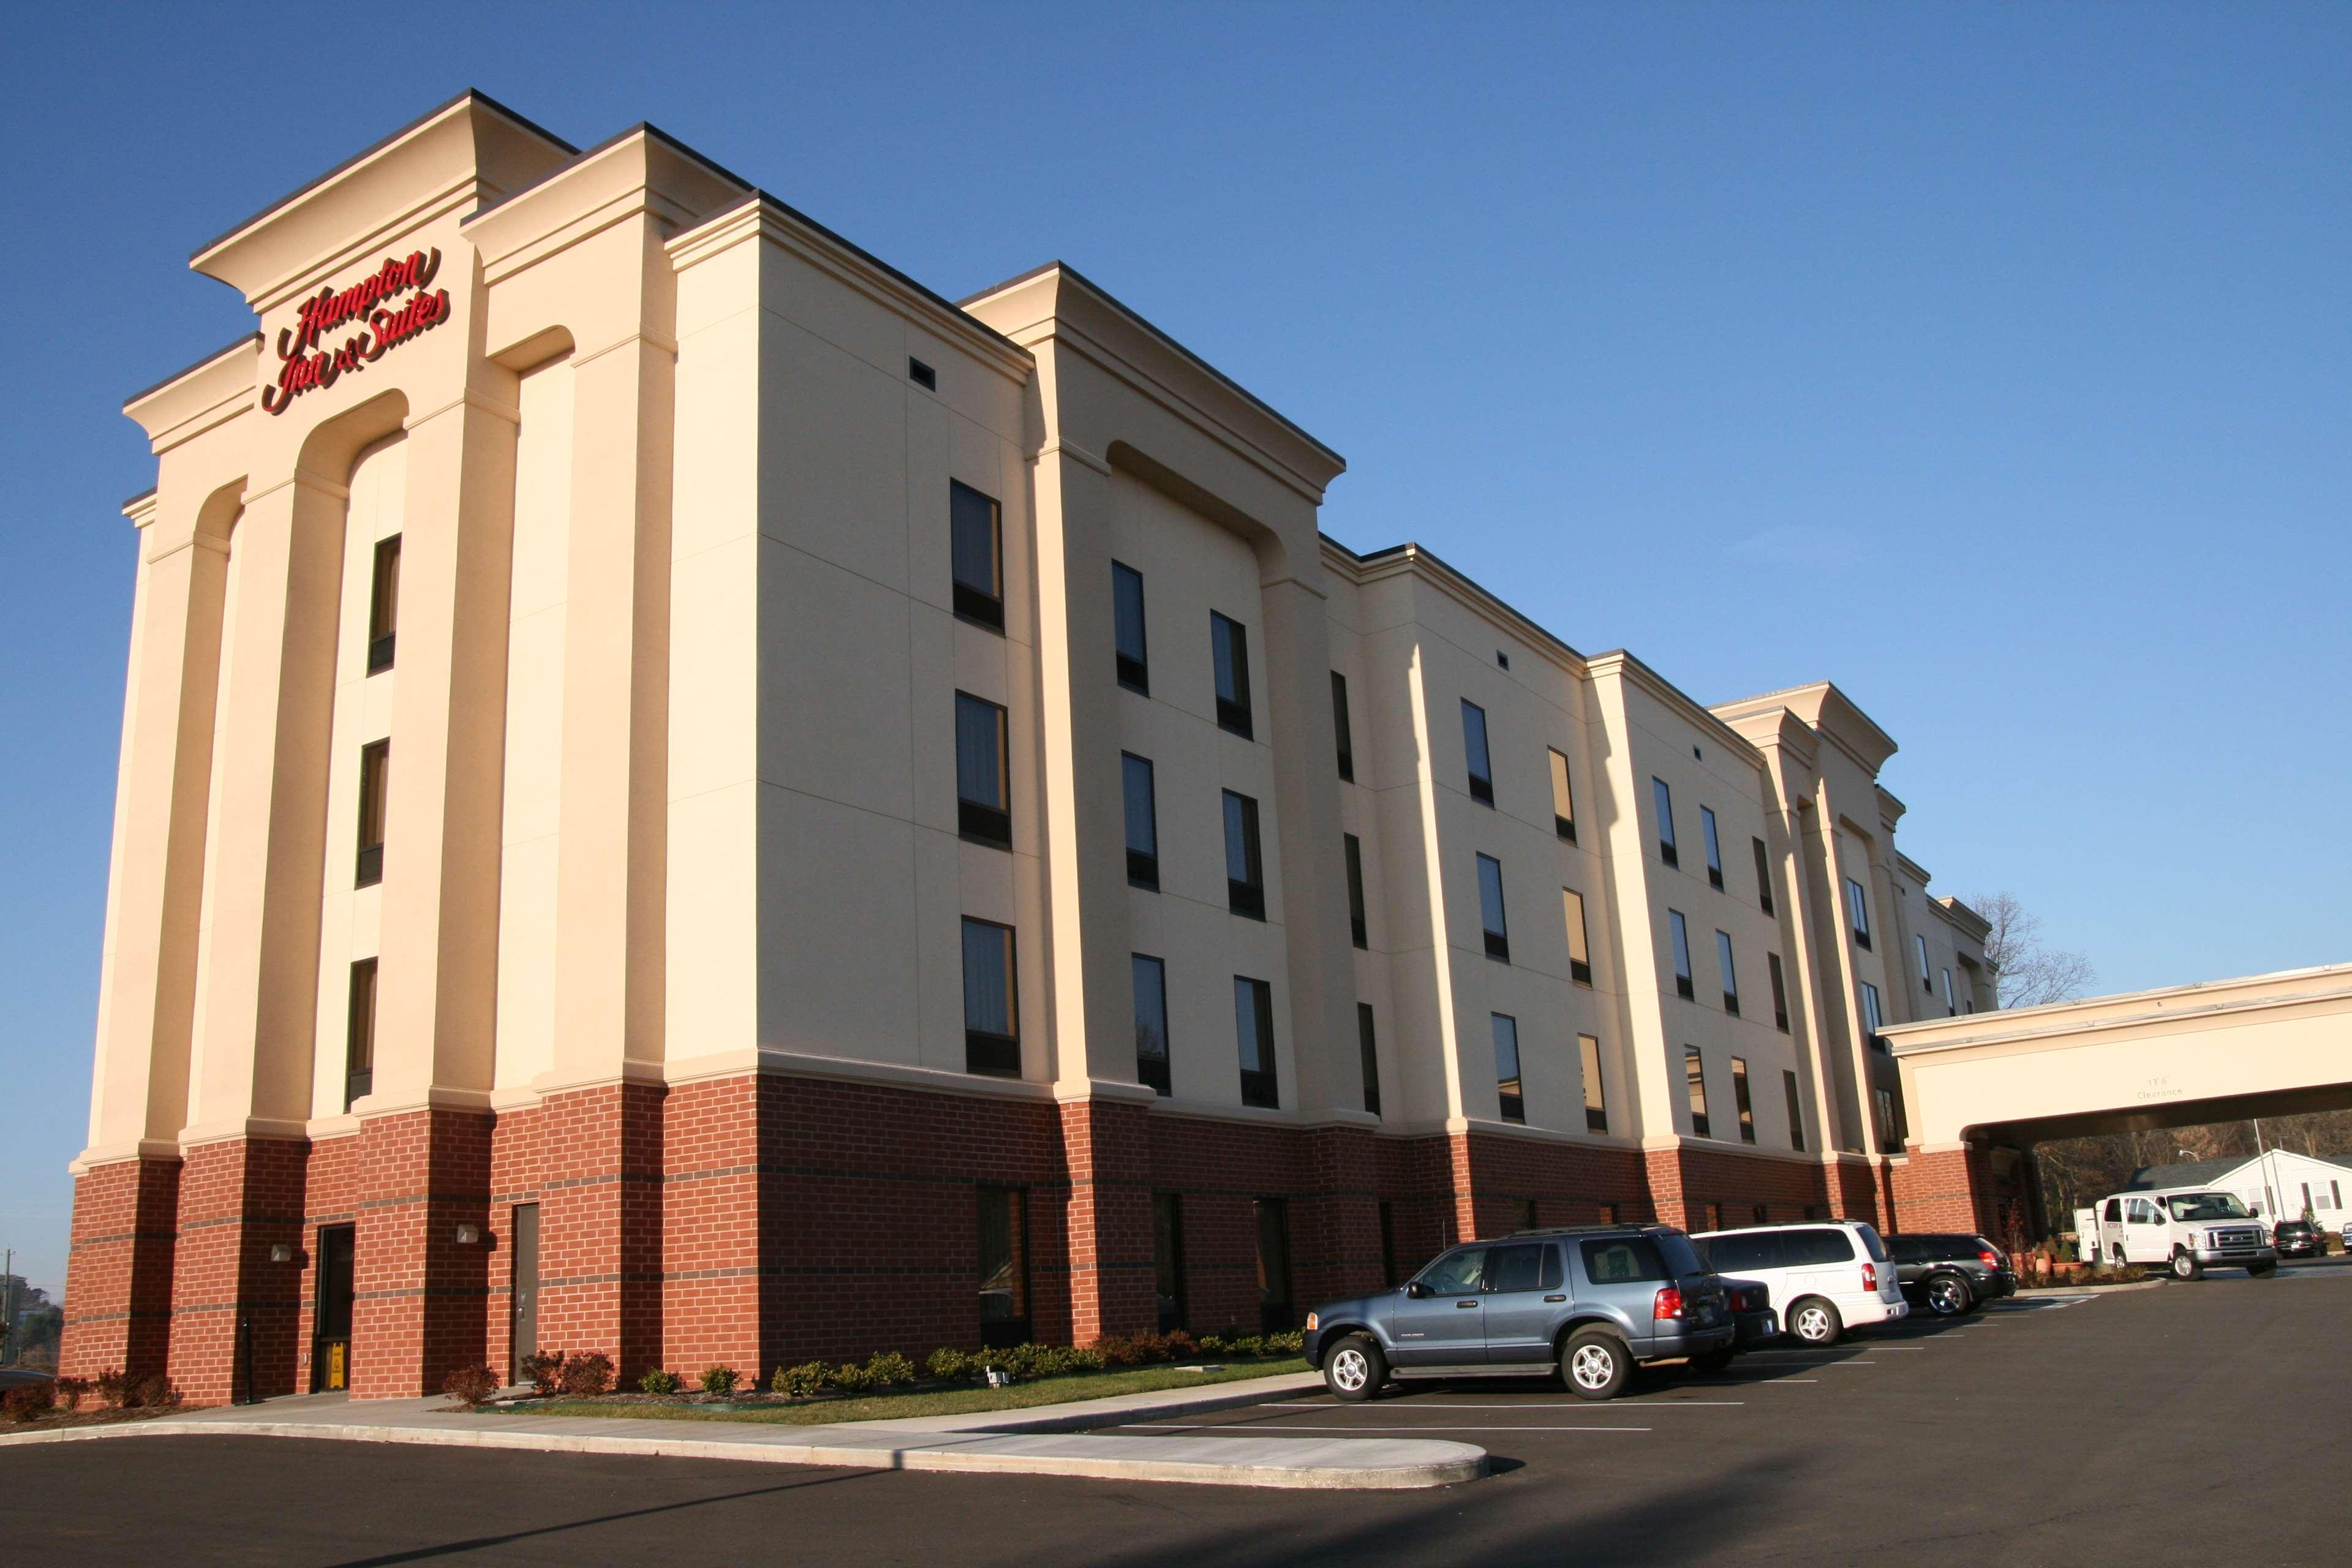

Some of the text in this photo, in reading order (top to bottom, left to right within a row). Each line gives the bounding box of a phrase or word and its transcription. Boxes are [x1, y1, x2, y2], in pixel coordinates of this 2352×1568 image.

[262, 351, 341, 416] Inn
[356, 288, 451, 362] Suites
[277, 246, 441, 360] Hampton
[2137, 1088, 2182, 1099] Clearance
